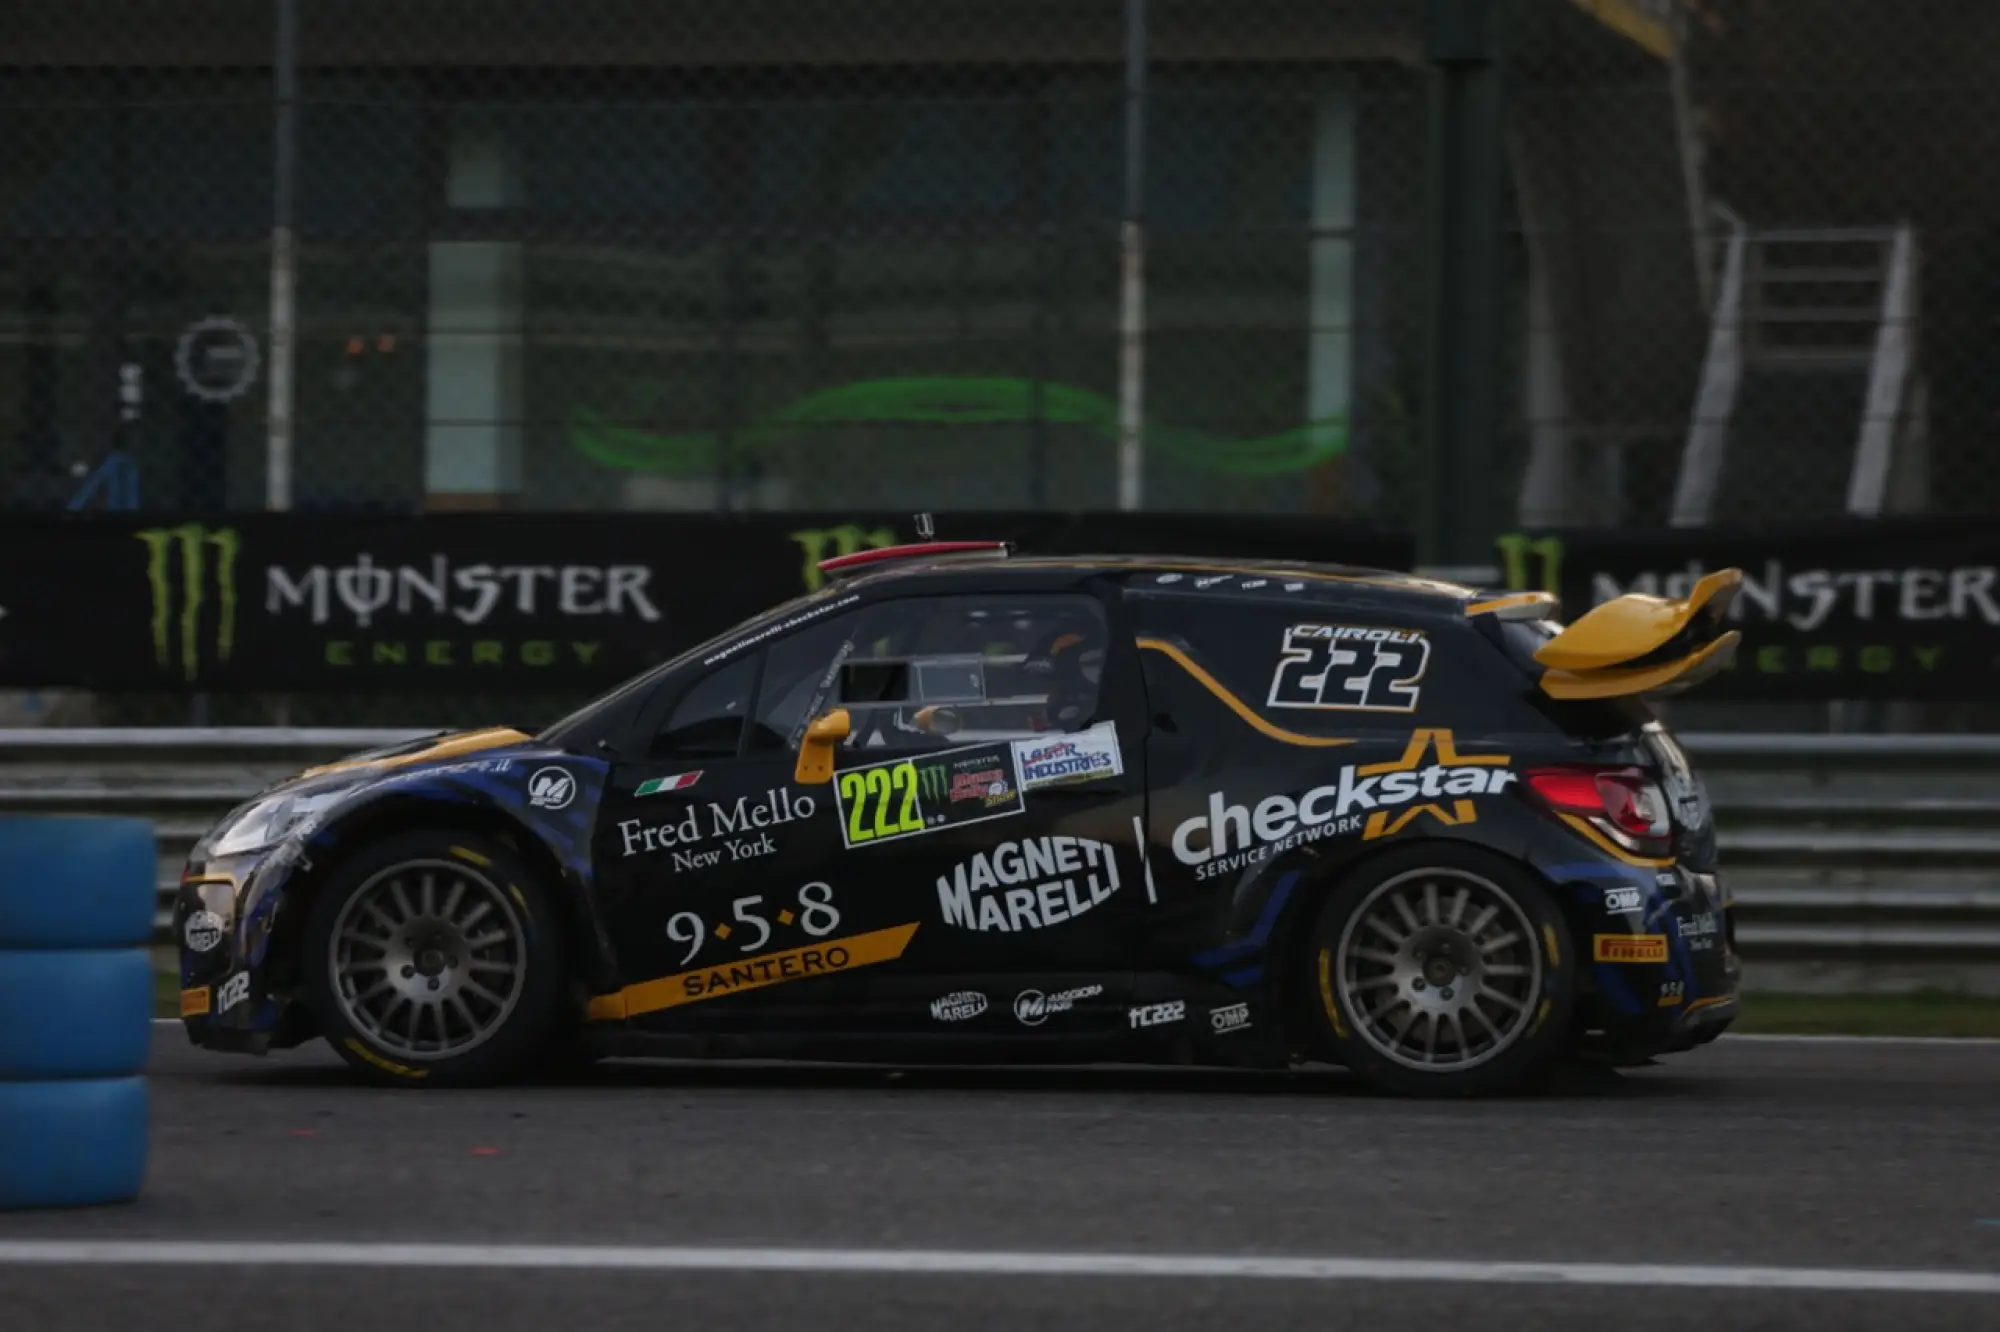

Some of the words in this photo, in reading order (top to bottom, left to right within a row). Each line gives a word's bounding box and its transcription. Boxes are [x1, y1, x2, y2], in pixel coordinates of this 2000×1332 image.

[265, 553, 662, 628] MONSTER
[324, 639, 602, 666] ENERGY
[1290, 622, 1423, 645] CAIROLI
[1266, 627, 1432, 713] 222
[617, 804, 704, 857] Fred
[707, 786, 816, 838] Mello
[840, 762, 925, 843] 222
[1171, 764, 1519, 867] checkstar
[671, 848, 722, 873] New
[723, 831, 778, 863] York
[936, 836, 1120, 903] MAGNETI
[1194, 845, 1267, 882] SERVICE
[1273, 813, 1363, 855] NETWORK
[936, 862, 1120, 932] MARELLI
[682, 946, 850, 997] SANTERO
[1210, 1008, 1250, 1030] OMP
